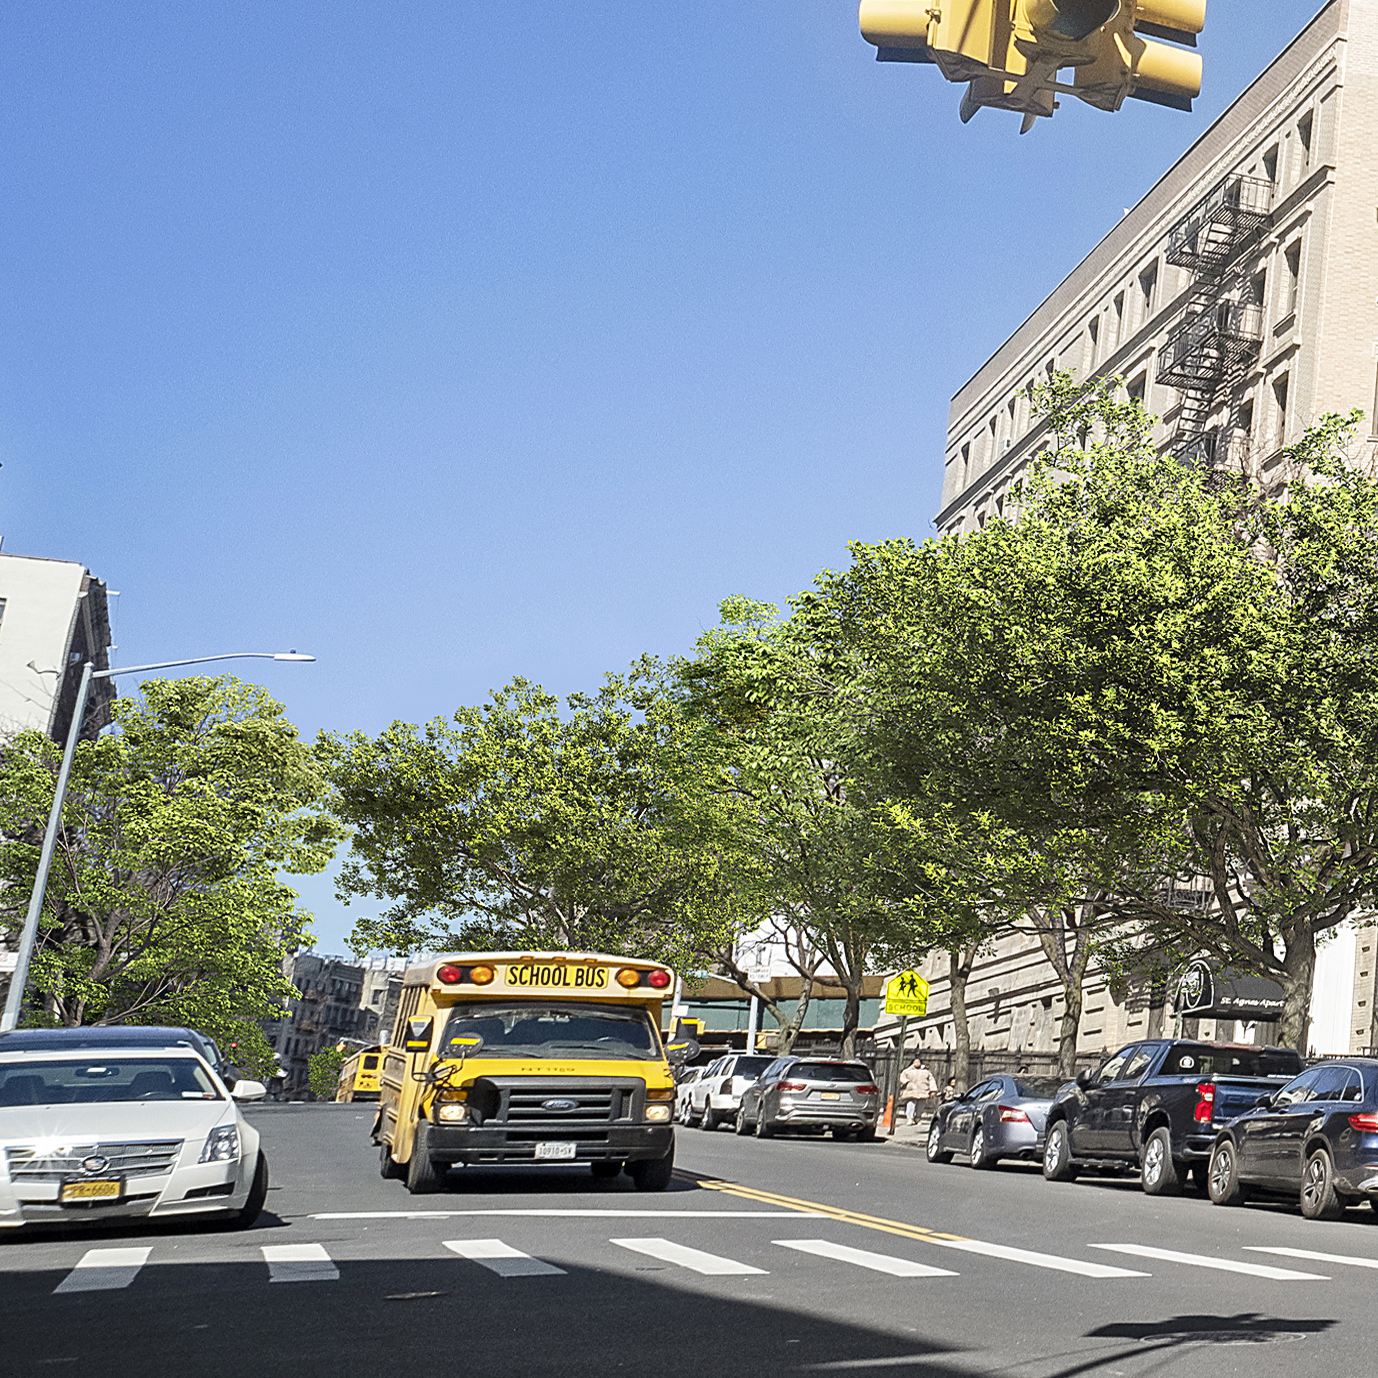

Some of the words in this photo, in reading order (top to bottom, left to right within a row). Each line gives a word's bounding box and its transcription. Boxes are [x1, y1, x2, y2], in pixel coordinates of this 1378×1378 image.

[508, 966, 571, 987] SCHOOL
[575, 968, 606, 988] BUS
[888, 1004, 924, 1013] SCHOOL
